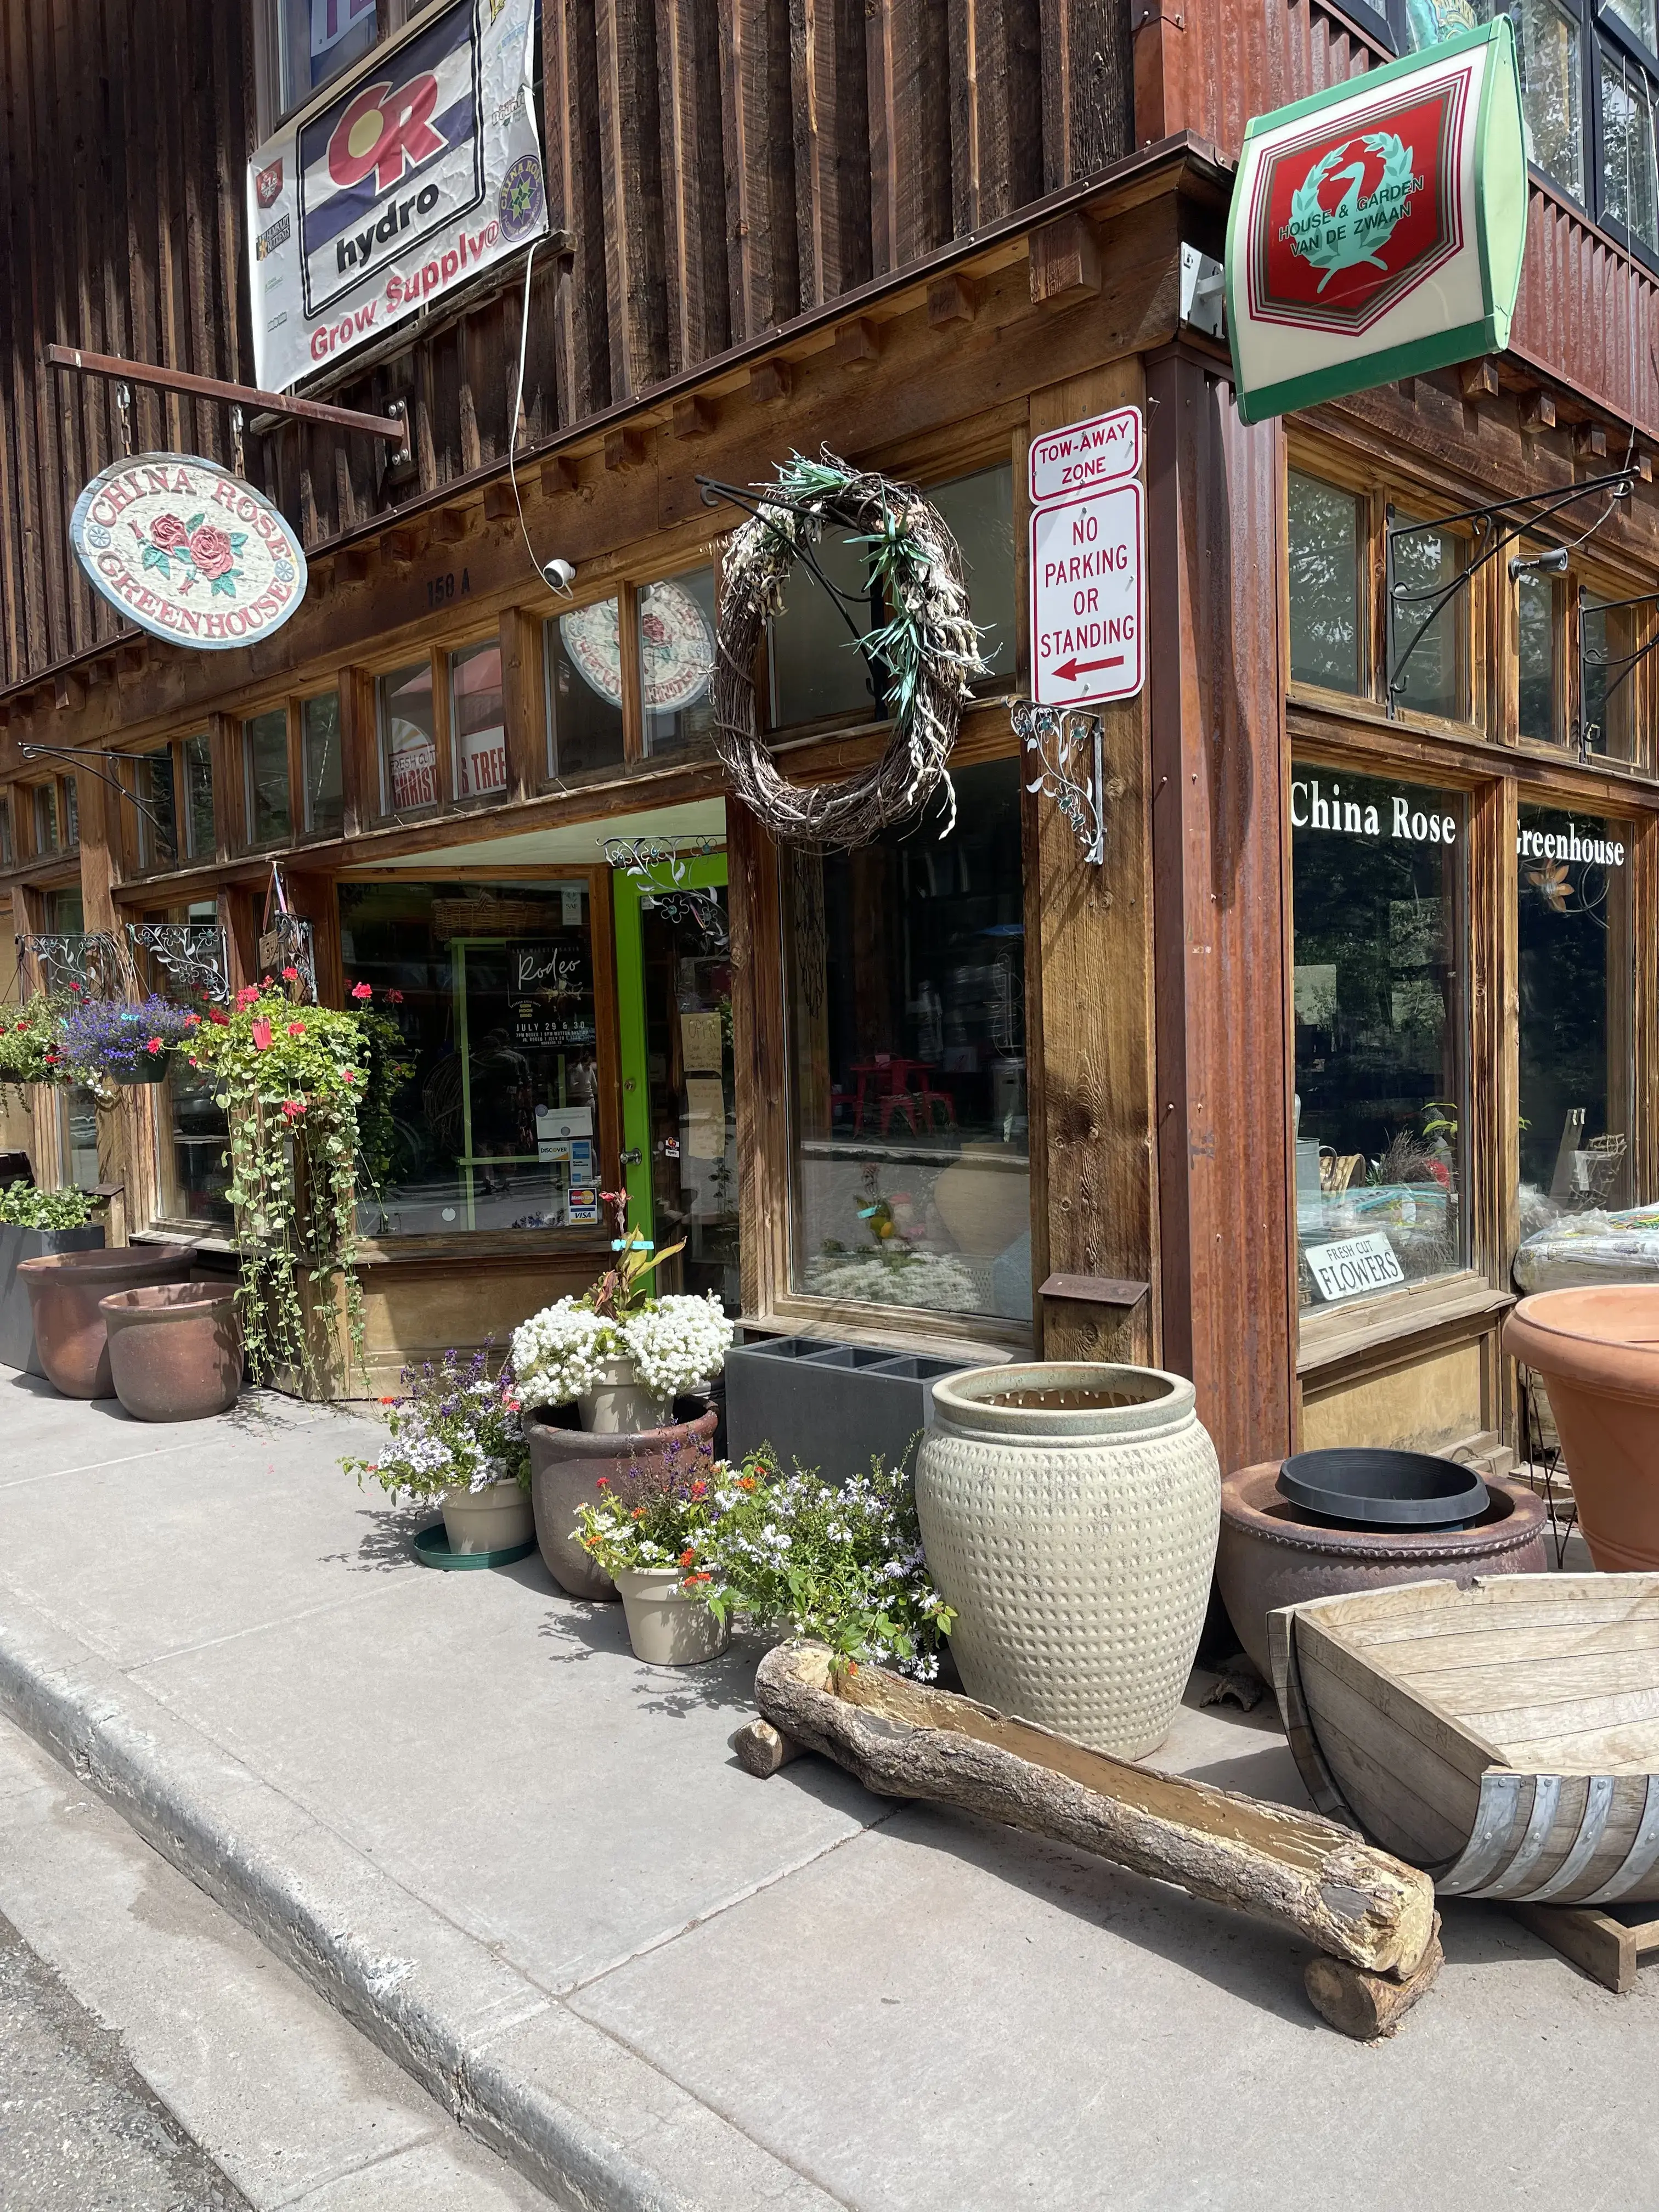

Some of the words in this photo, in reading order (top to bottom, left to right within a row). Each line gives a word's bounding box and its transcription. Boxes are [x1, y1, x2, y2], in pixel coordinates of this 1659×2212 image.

[501, 162, 524, 210] CHINA
[1278, 208, 1332, 242] HOUSE
[1339, 204, 1348, 219] &
[1356, 174, 1424, 212] GARDEN
[336, 184, 439, 274] hydro
[1290, 235, 1319, 257] VAN
[1327, 225, 1346, 245] DE
[1353, 201, 1412, 235] ZWAAN
[311, 300, 377, 361] Grow
[1039, 420, 1130, 465] TOW-AWAY
[1062, 456, 1106, 484] ZONE
[92, 466, 197, 527] CHINA
[211, 479, 292, 561] ROSE
[1073, 516, 1098, 546] NO
[461, 567, 470, 595] A
[1046, 544, 1127, 588] PARKING
[97, 550, 292, 639] GREENHOUSE
[1074, 588, 1098, 616] OR
[1041, 614, 1135, 658] STANDING
[391, 755, 416, 772] FRESH
[419, 750, 436, 765] CUT
[1291, 780, 1380, 836] China
[1391, 796, 1456, 844] Rose
[518, 947, 582, 990] Rodeo
[516, 1023, 539, 1032] JULY
[545, 1022, 556, 1030] 29
[562, 1022, 568, 1030] &
[573, 1021, 585, 1029] 30
[688, 1019, 716, 1040] OPEN
[1326, 1244, 1355, 1261] FRESH
[1356, 1240, 1373, 1254] CUT
[1318, 1251, 1398, 1295] FLOWERS
